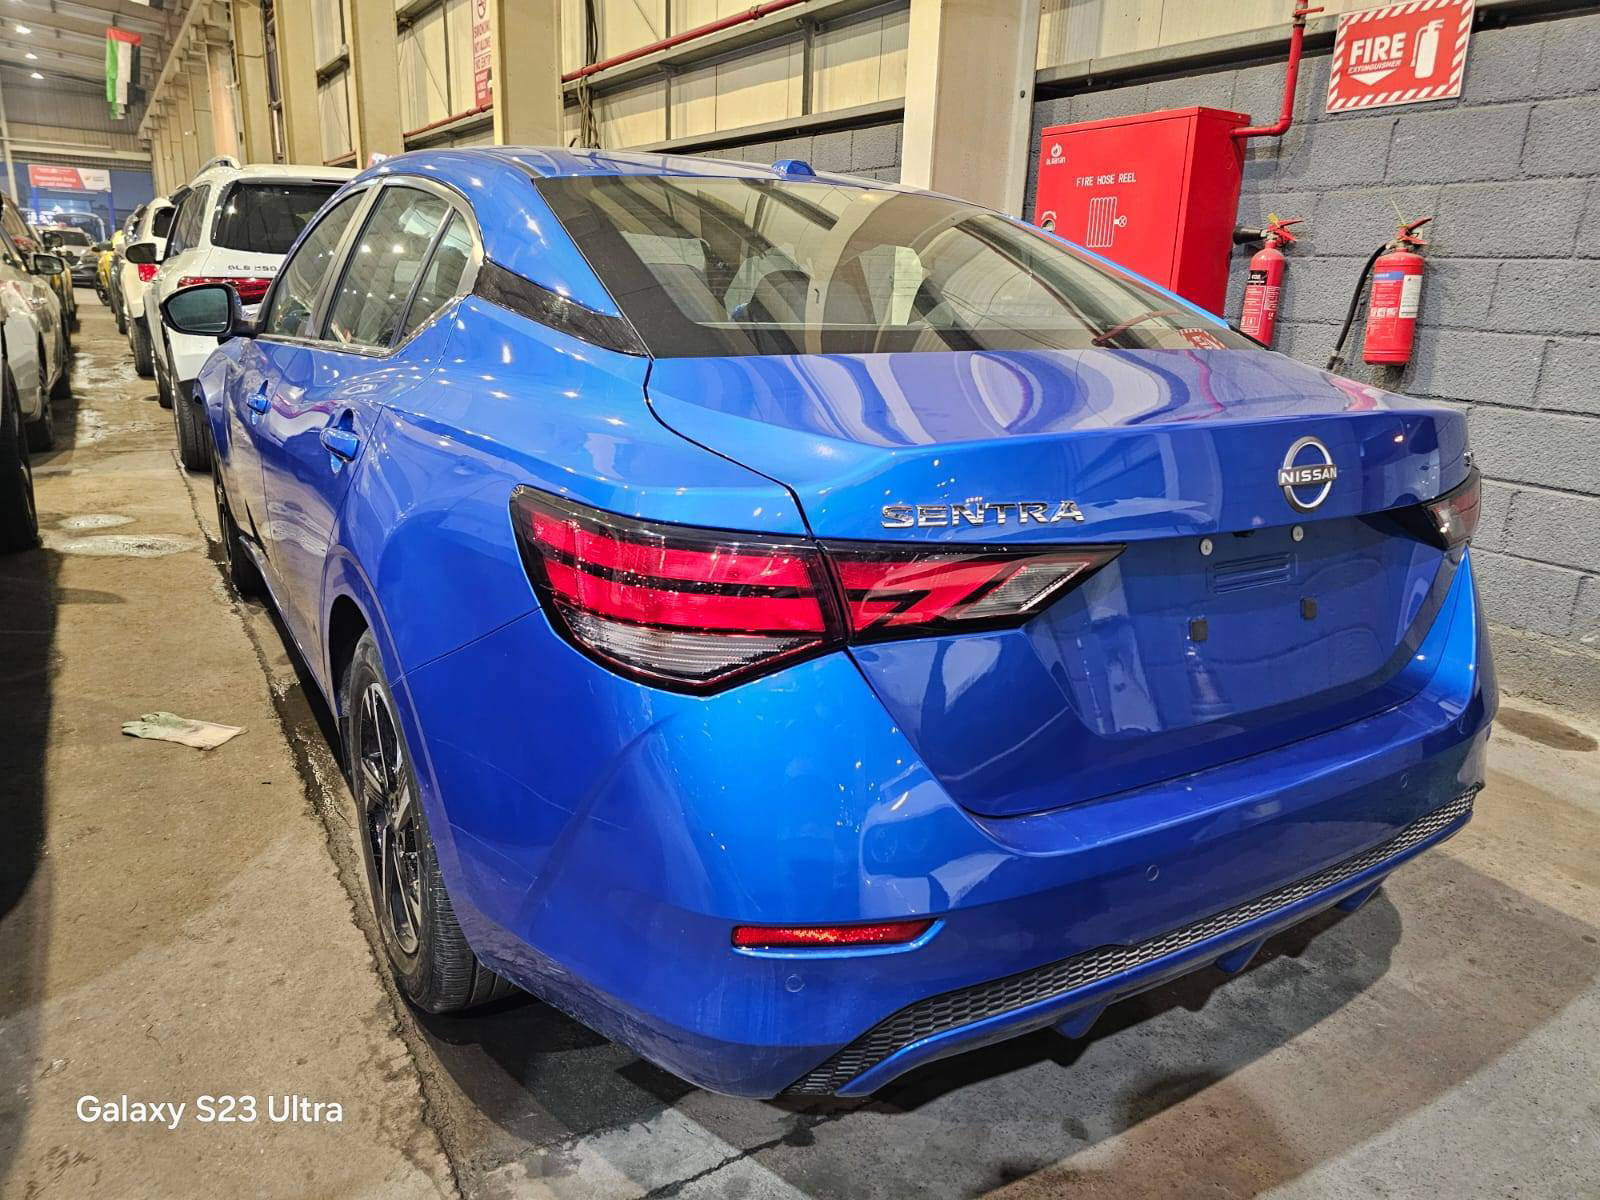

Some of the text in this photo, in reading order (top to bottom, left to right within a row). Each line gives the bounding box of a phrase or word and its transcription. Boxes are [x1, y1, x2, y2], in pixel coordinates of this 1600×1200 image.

[1349, 32, 1406, 66] FIRE
[1347, 60, 1402, 74] EXTINGUISHER
[1076, 172, 1137, 187] FIRE HOSE REEL
[1280, 466, 1337, 484] NISSAN
[881, 500, 1086, 529] SENTRA
